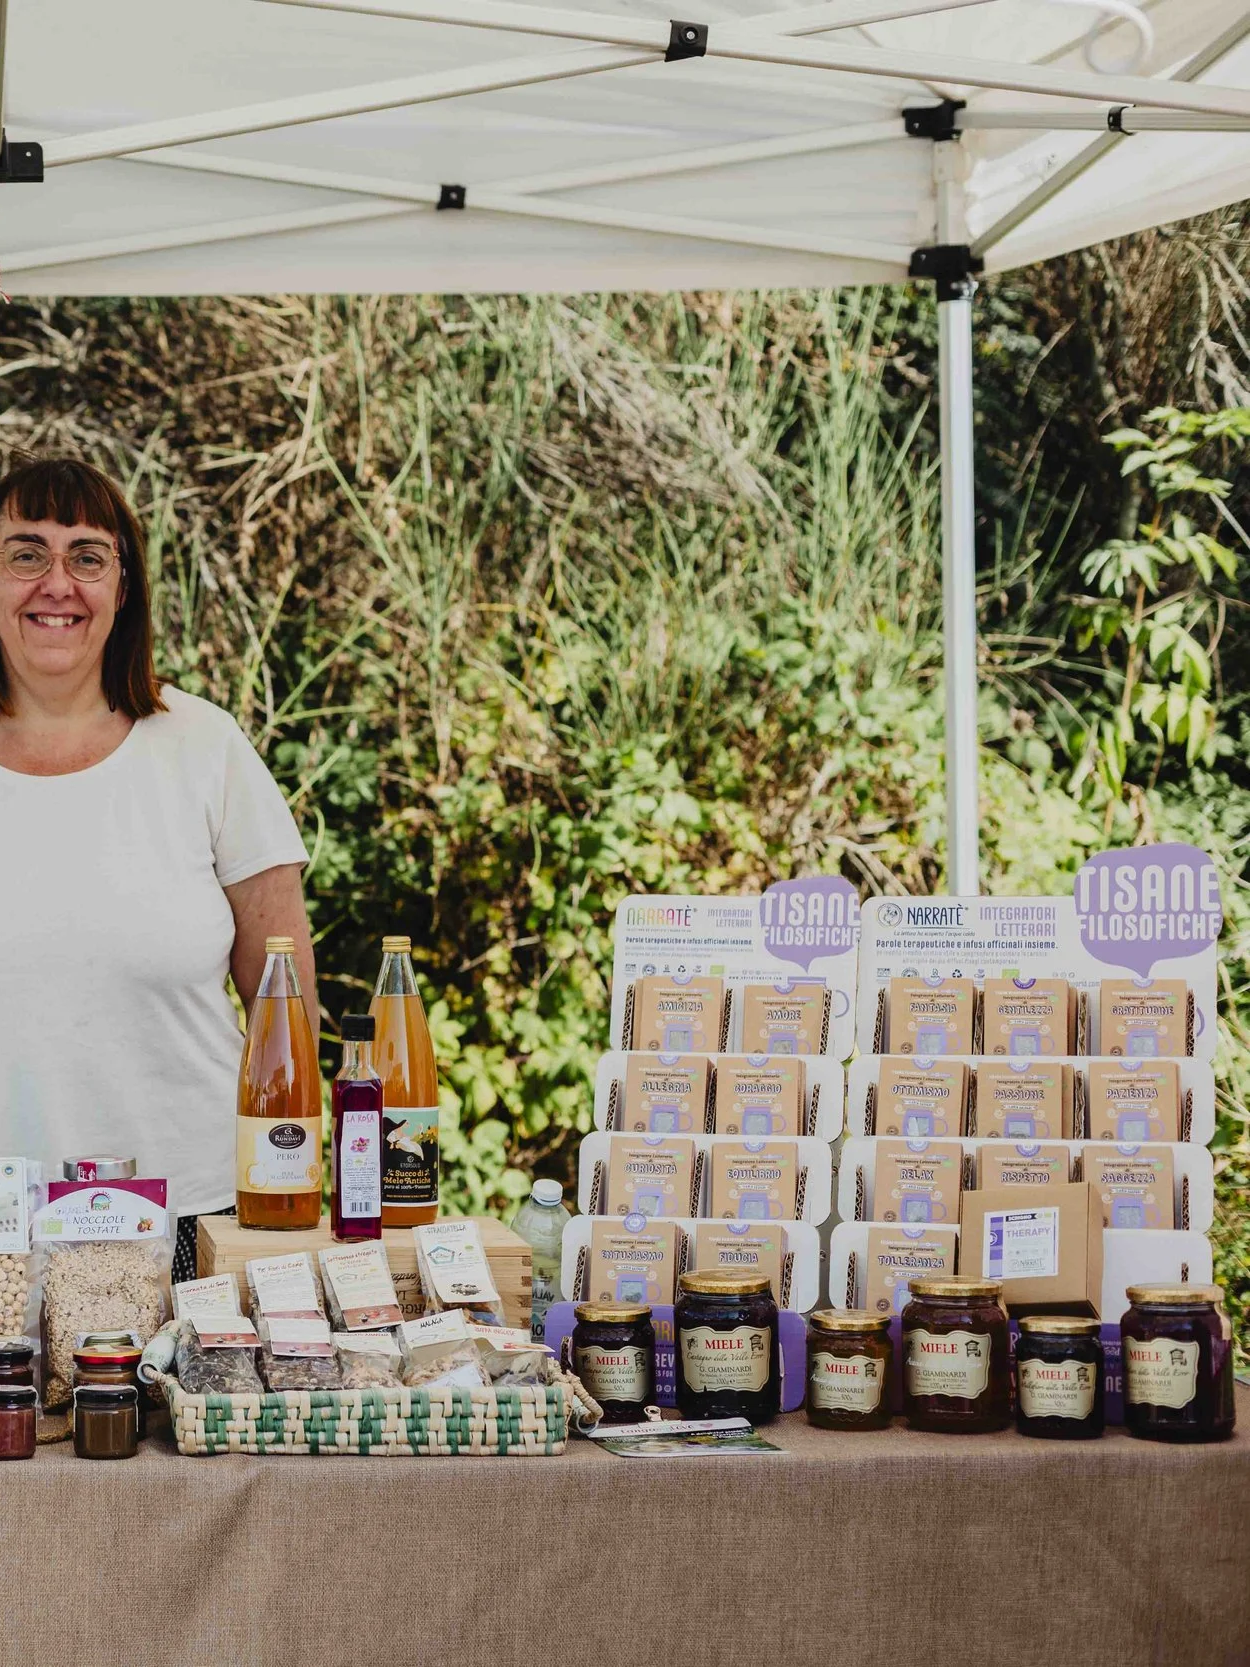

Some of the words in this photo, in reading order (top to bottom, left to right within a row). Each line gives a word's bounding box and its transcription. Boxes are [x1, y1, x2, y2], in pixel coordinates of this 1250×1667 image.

[1077, 864, 1221, 913] TISANE
[707, 909, 753, 918] INTEGRATORI
[762, 892, 861, 927] TISANE
[907, 904, 964, 926] NARRATÈ
[979, 906, 1056, 921] INTEGRATORI
[715, 919, 752, 928] LETTERARI
[1077, 913, 1223, 941] FILOSOFICHE
[995, 923, 1056, 937] LETTERARI
[645, 936, 682, 945] terapeutiche
[704, 937, 729, 945] officinali
[762, 926, 862, 946] FILOSOFICHE
[876, 939, 902, 948] Parole
[903, 939, 955, 950] terapeutiche
[963, 939, 986, 949] infusi
[987, 939, 1023, 949] officinali
[658, 1001, 704, 1012] AMICIZIA
[909, 1002, 957, 1013] FANTASIA
[997, 1004, 1054, 1015] GENTILEZZA
[1111, 1005, 1175, 1015] GRATITUDINE
[765, 1009, 802, 1021] AMORE
[641, 1082, 692, 1093] ALLEGRIA
[733, 1083, 782, 1094] CORAGGIO
[891, 1084, 950, 1098] OTTIMISMO
[993, 1089, 1046, 1101] PASSIONE
[1106, 1088, 1158, 1099] PAZIENZA
[346, 1114, 355, 1122] LA
[357, 1113, 375, 1122] ROSA
[417, 1169, 424, 1177] di
[726, 1168, 782, 1180] EQUILIBRIO
[900, 1168, 934, 1180] RELAX
[1001, 1171, 1051, 1184] RISPETTO
[1101, 1172, 1156, 1183] SAGGEZZA
[382, 1176, 404, 1184] Mele
[72, 1215, 126, 1225] NOCCIOLE
[77, 1225, 121, 1235] TOSTATE
[1006, 1227, 1051, 1238] THERAPY
[601, 1249, 664, 1262] ENTUSIASMO
[718, 1252, 759, 1264] FIDUCIA
[877, 1255, 945, 1268] TOLLERANZA
[420, 1317, 444, 1329] MALAGA
[705, 1338, 744, 1350] MIELE
[920, 1342, 958, 1354] MIELE
[596, 1356, 630, 1366] MIELE
[1129, 1349, 1162, 1363] MIELE
[708, 1365, 752, 1373] GIAMINARDI
[824, 1362, 859, 1375] MIELE
[922, 1370, 967, 1378] GIAMINARDI
[1036, 1369, 1071, 1380] MIELE
